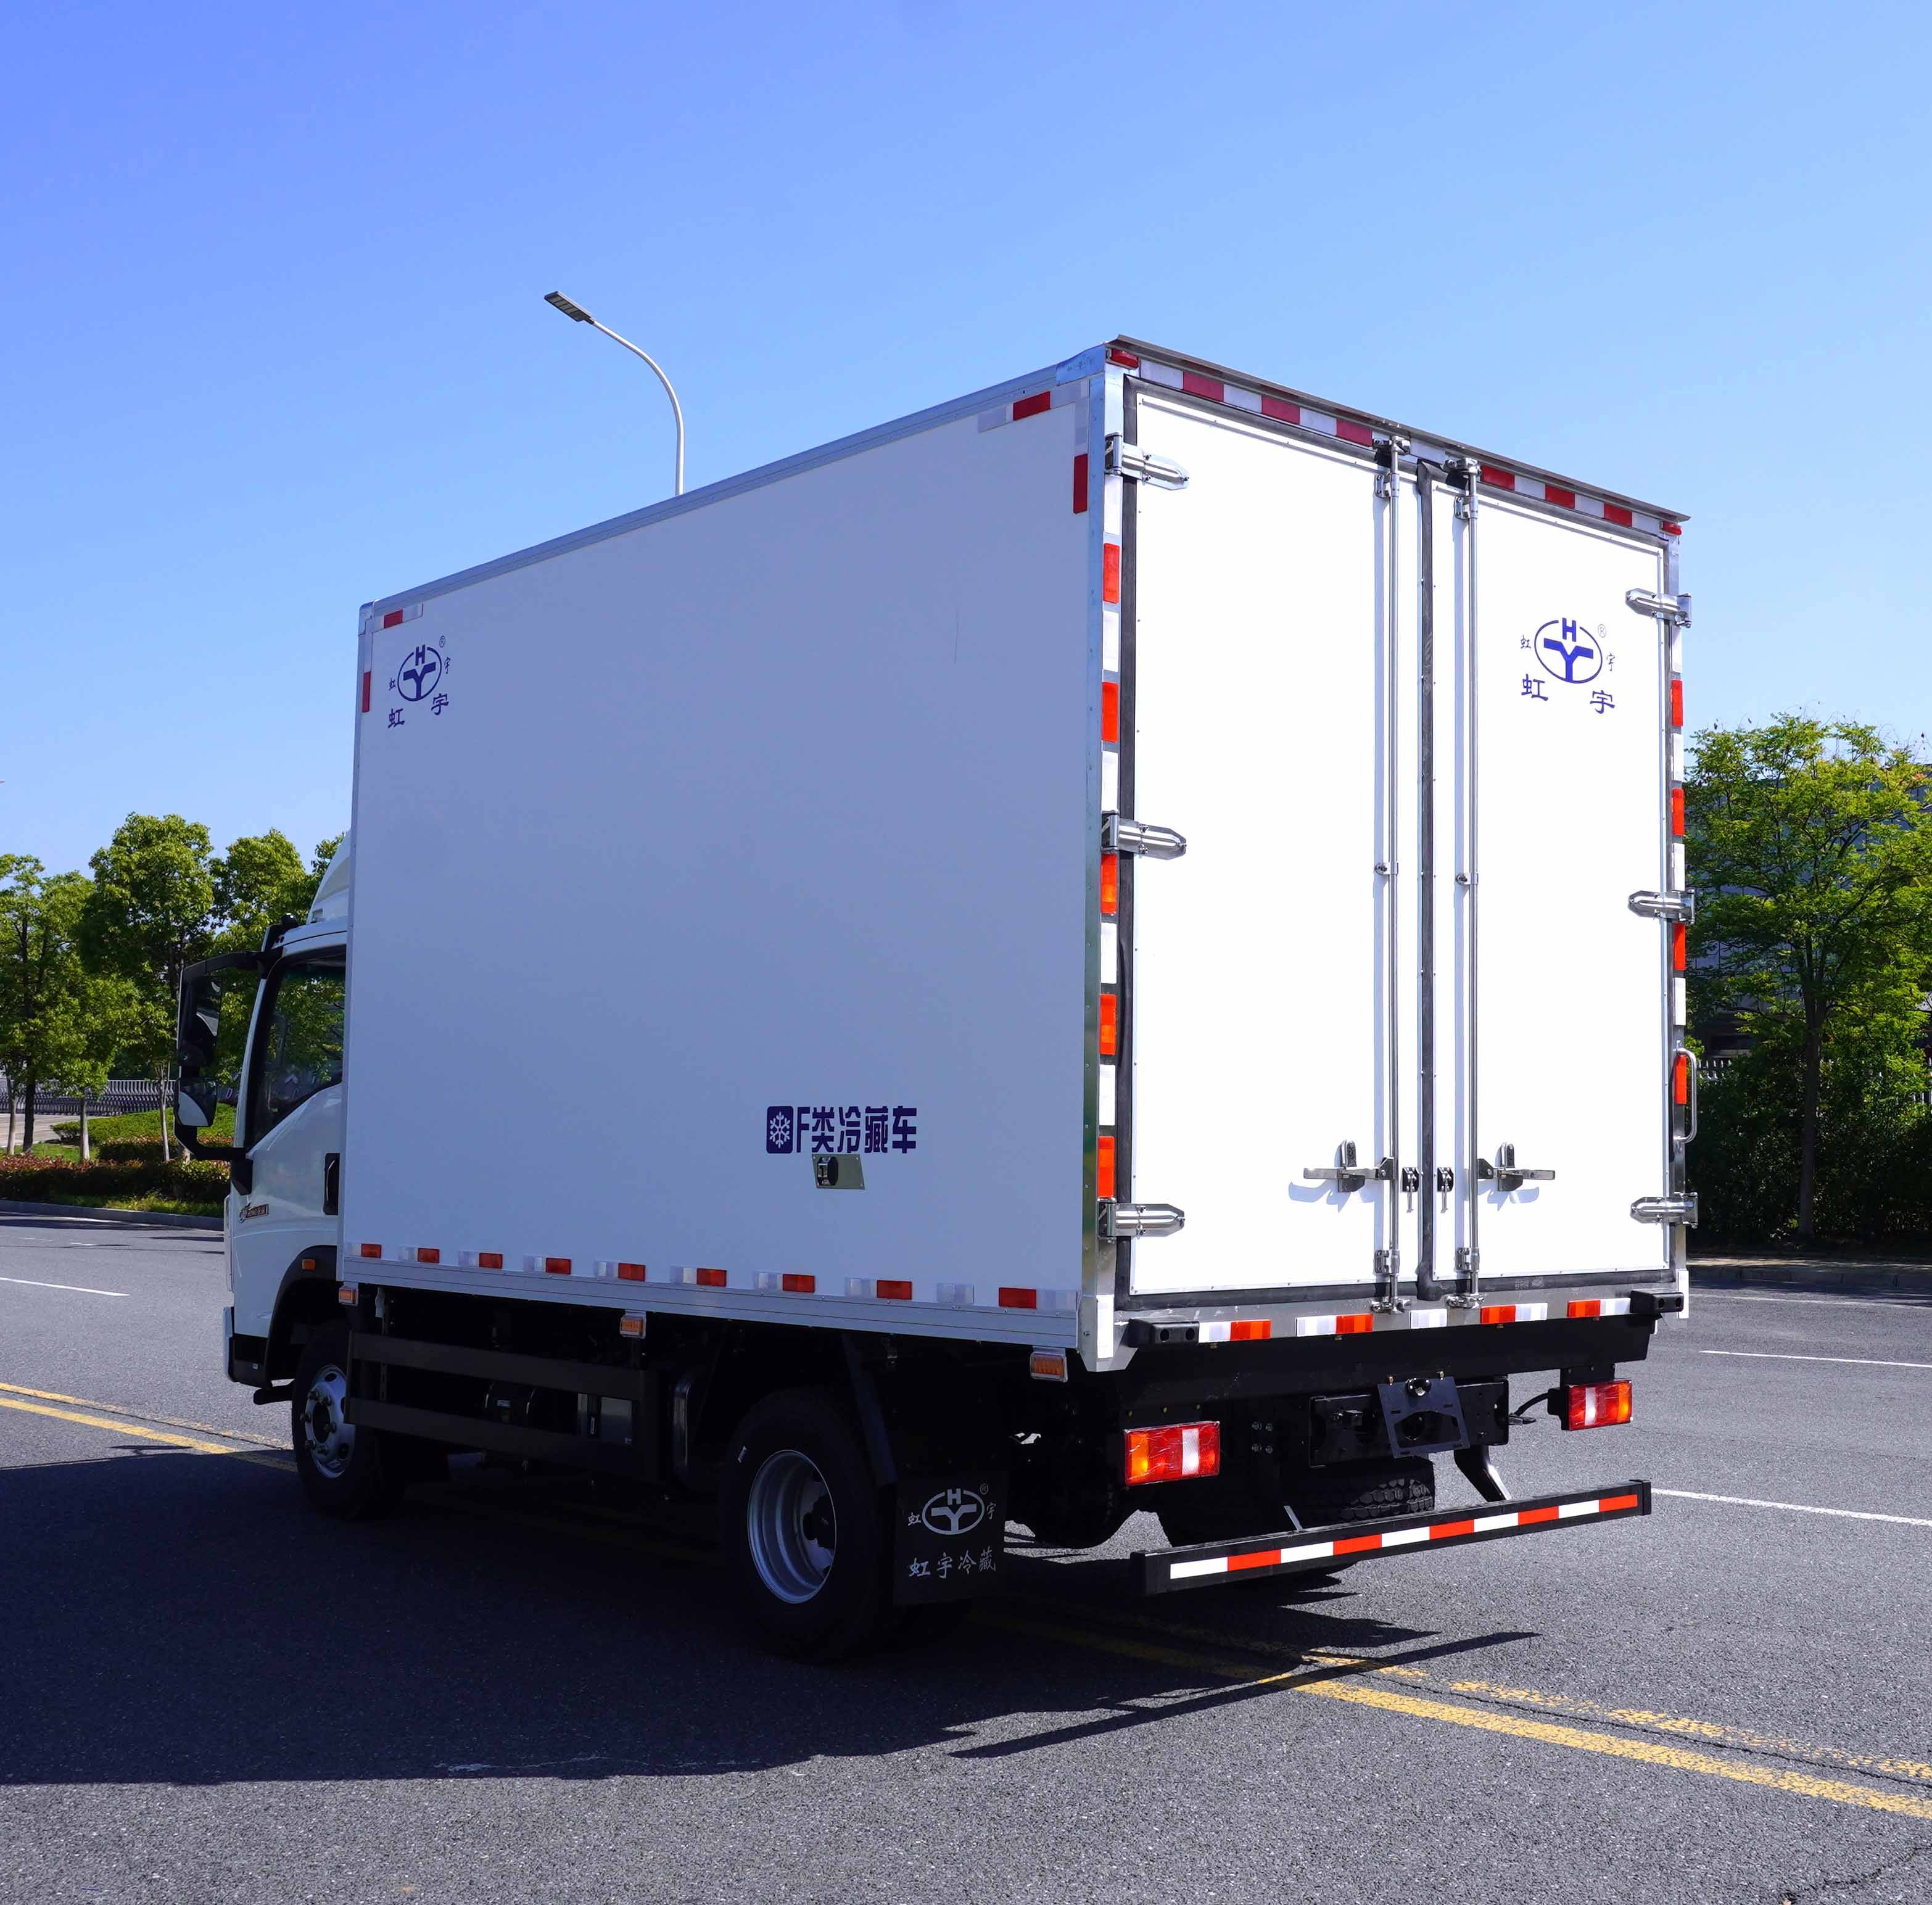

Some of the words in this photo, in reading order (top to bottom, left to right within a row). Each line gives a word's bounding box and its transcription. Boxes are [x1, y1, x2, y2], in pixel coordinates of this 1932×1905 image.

[796, 1105, 917, 1154] F类冷藏车
[908, 1545, 997, 1579] 虹宇冷藏
